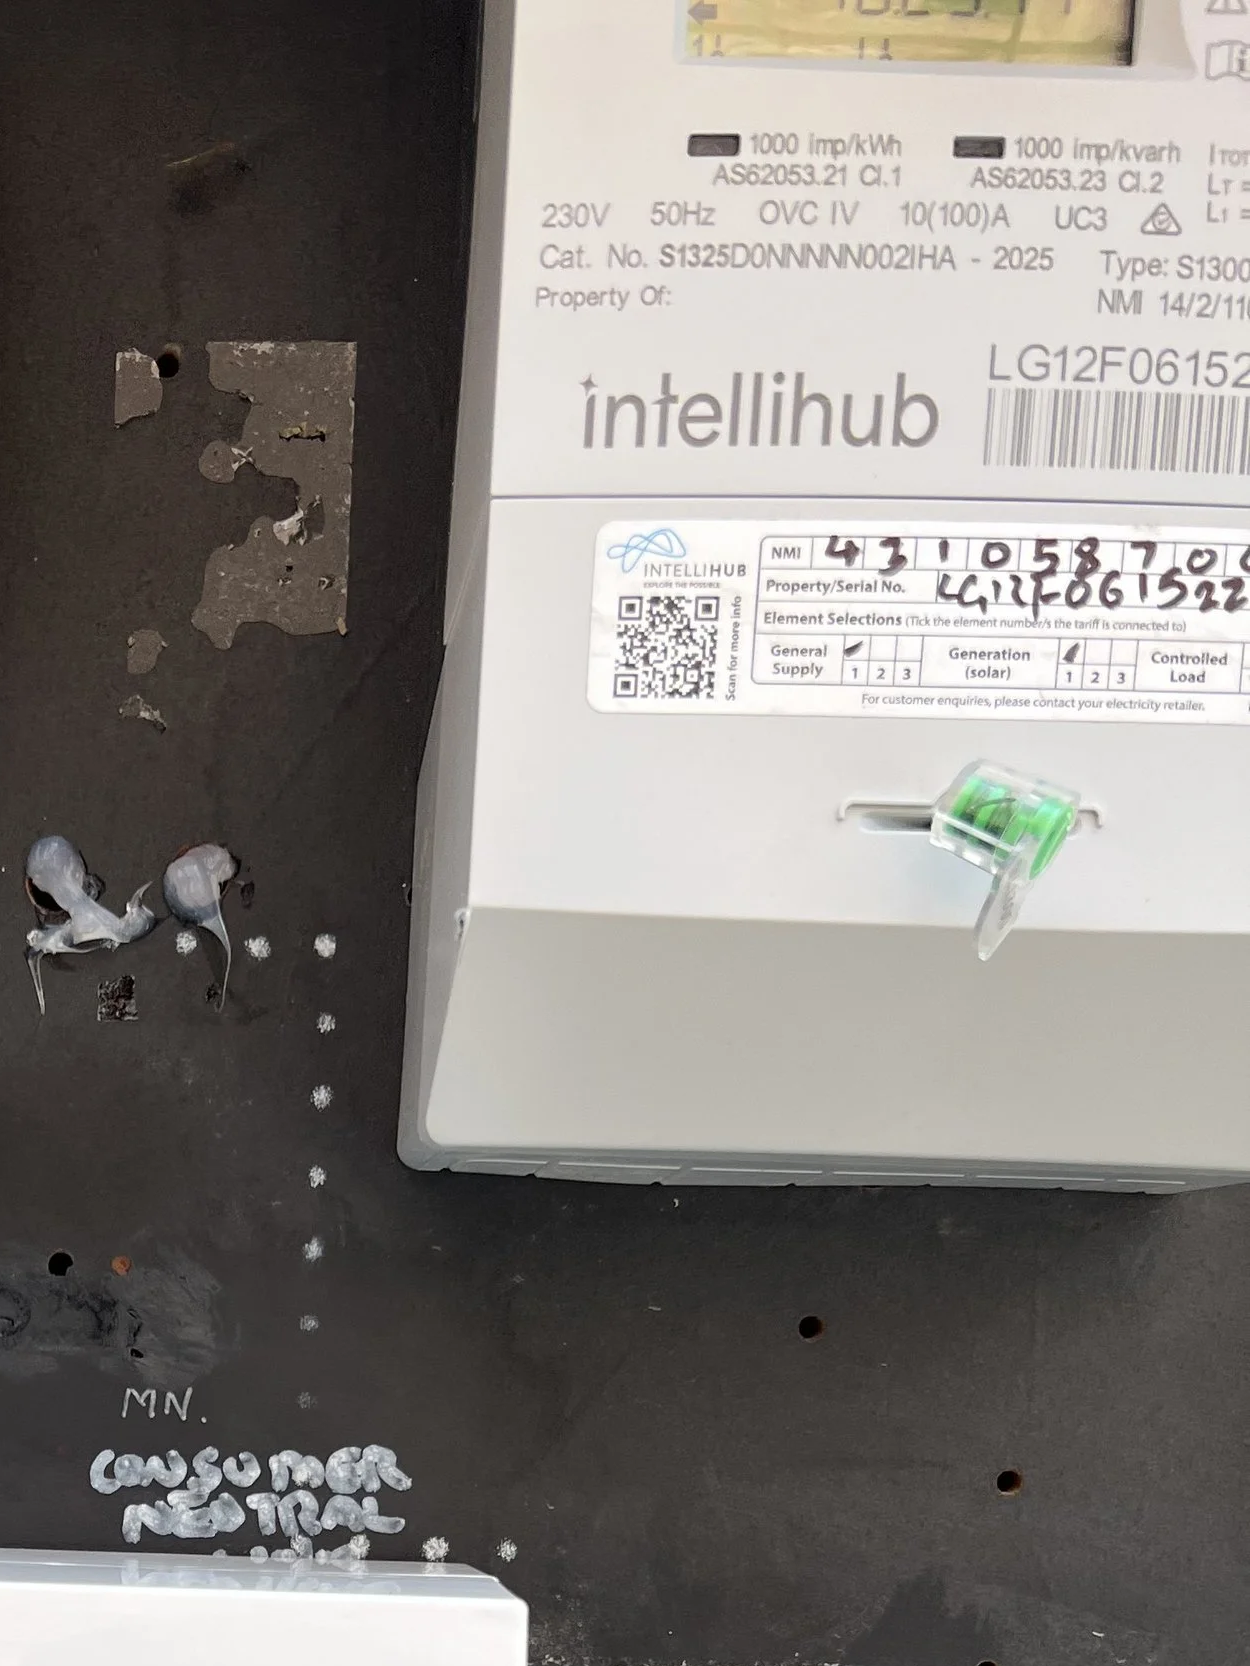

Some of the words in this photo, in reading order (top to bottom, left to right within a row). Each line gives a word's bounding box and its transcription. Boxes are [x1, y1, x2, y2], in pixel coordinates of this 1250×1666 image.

[749, 133, 799, 155] 1000
[808, 133, 902, 159] imp/kWh
[1014, 137, 1063, 159] 1000
[1073, 139, 1181, 164] imp/kvarh
[712, 163, 847, 186] AS62053.21
[970, 167, 1107, 192] AS62053.23
[541, 202, 611, 228] 230V
[649, 201, 717, 226] 50Hz
[759, 200, 819, 226] OVC
[830, 200, 860, 226] IV
[899, 201, 1010, 234] 10(100)A
[1054, 204, 1108, 231] UC3
[539, 243, 592, 269] Cat.
[607, 243, 649, 269] No.
[993, 247, 1054, 271] 2025
[1100, 250, 1168, 282] Type:
[1176, 254, 1250, 283] S1300
[535, 287, 630, 312] Property
[640, 285, 673, 306] Of:
[1098, 289, 1143, 315] NMI
[1159, 291, 1250, 320] 14/2/11
[988, 343, 1250, 390] LG12F06152
[578, 371, 940, 450] intellihub
[771, 546, 802, 560] NMI
[643, 563, 748, 578] INTELLIHUB
[766, 579, 878, 596] Property/Serial
[881, 580, 906, 593] No.
[730, 595, 742, 619] info
[763, 612, 824, 626] Element
[827, 613, 902, 627] Selections
[933, 615, 951, 628] the
[953, 616, 998, 628] element
[1000, 617, 1051, 630] number/s
[1054, 618, 1072, 630] the
[1074, 618, 1099, 631] tariff
[1102, 619, 1110, 631] is
[1113, 620, 1170, 632] connected
[1172, 621, 1187, 633] to)
[730, 621, 740, 652] more
[727, 654, 738, 671] for
[770, 644, 827, 658] General
[949, 647, 1031, 662] Generation
[1151, 651, 1228, 666] Controlled
[772, 662, 824, 678] Supply
[964, 665, 1011, 681] (solar)
[1170, 670, 1206, 683] Load
[725, 674, 737, 701] Scan
[861, 693, 880, 705] For
[882, 695, 935, 706] customer
[995, 697, 1036, 708] please
[1037, 698, 1075, 709] contact
[1077, 700, 1104, 711] your
[1106, 698, 1161, 711] electricity
